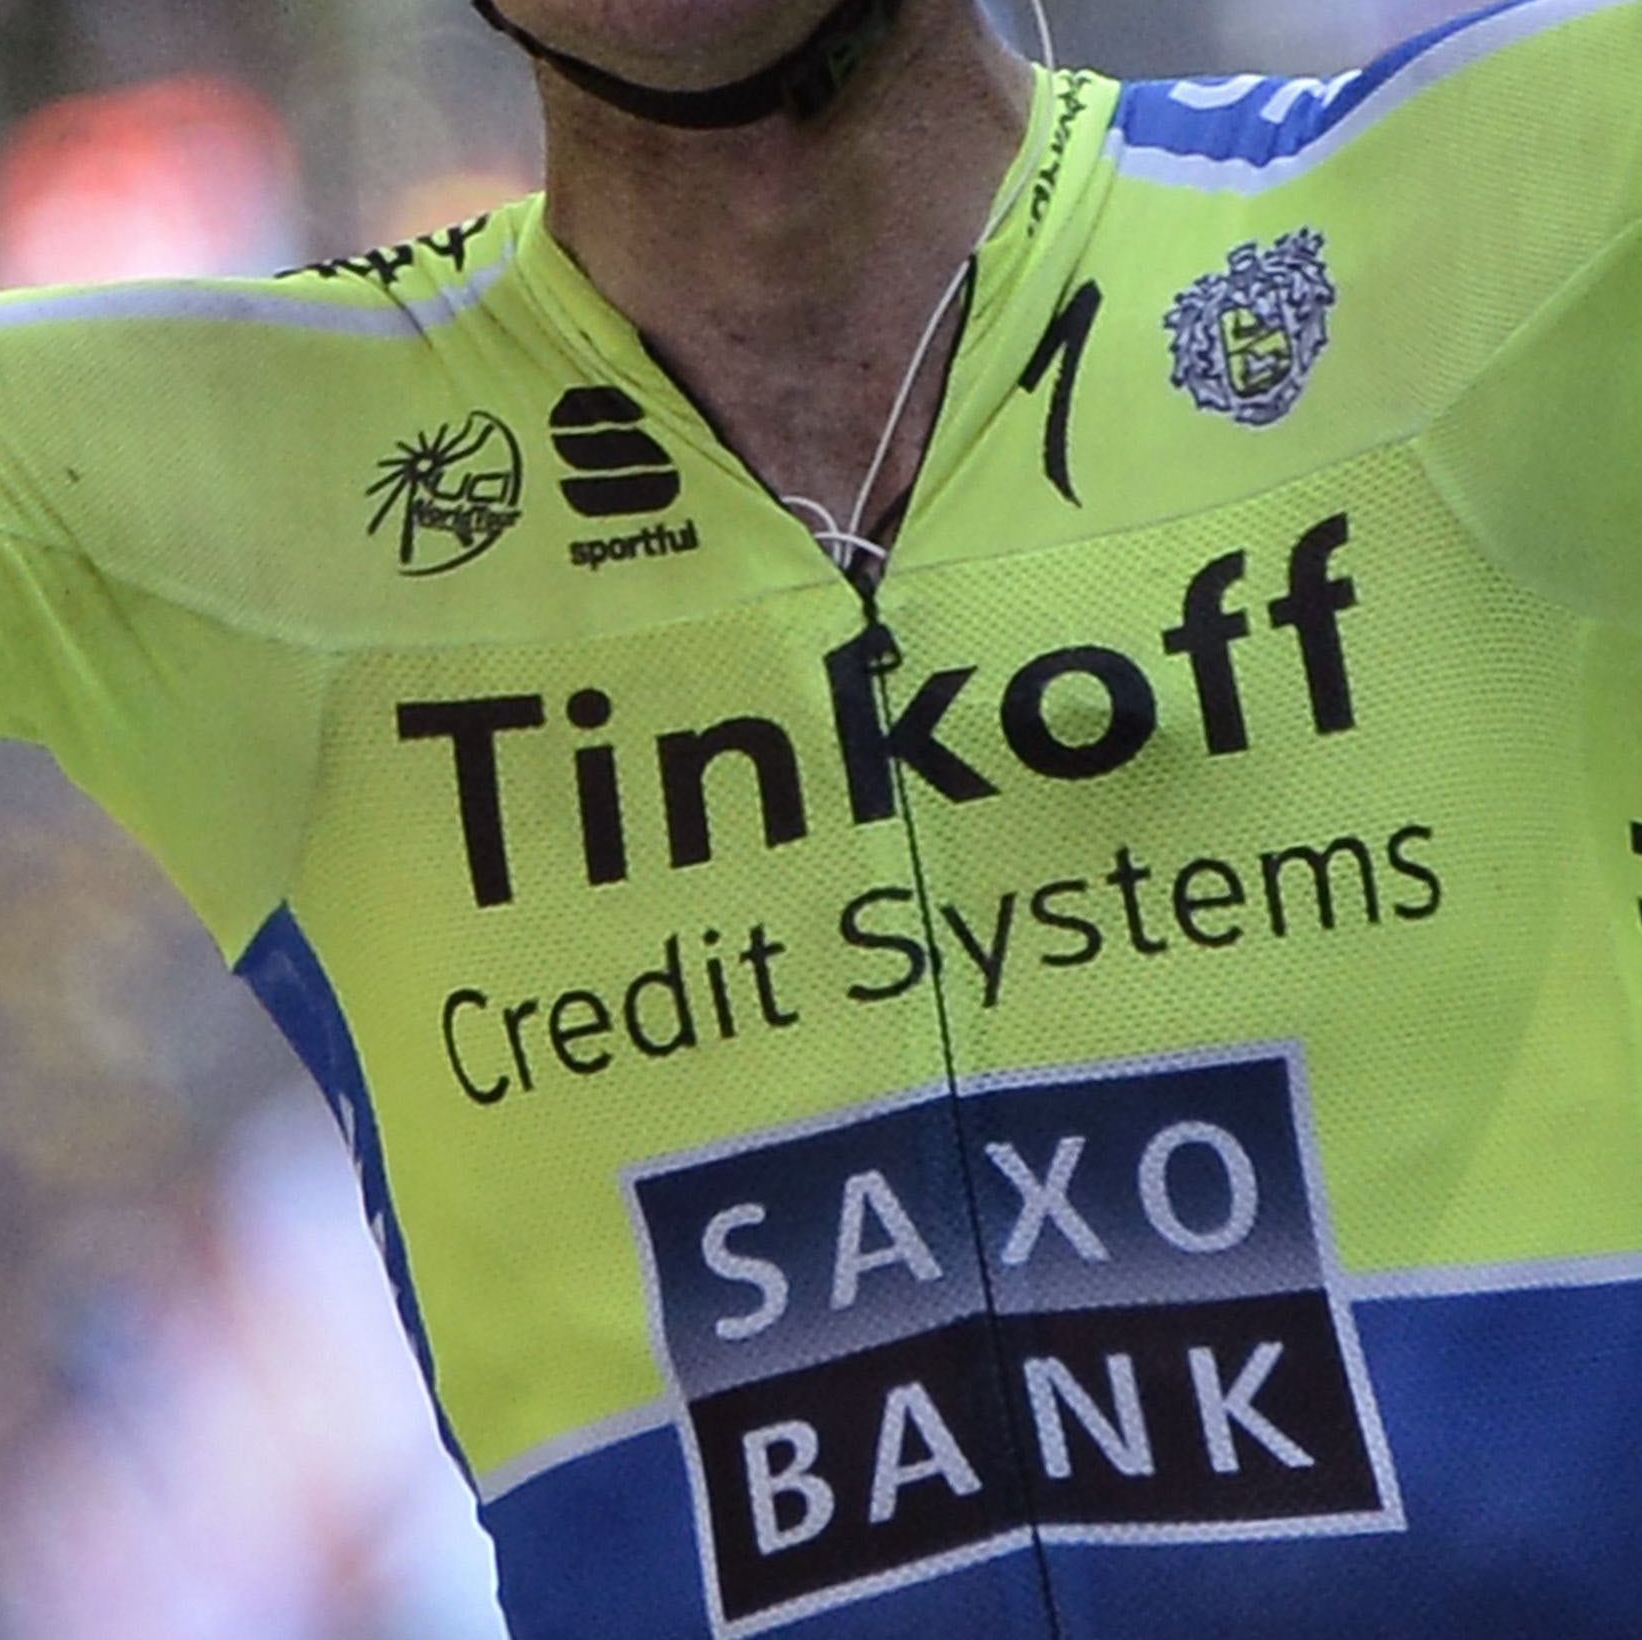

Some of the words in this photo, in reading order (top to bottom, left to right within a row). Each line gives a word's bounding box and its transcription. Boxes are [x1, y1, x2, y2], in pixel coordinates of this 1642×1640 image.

[569, 519, 699, 571] sportful
[396, 513, 1355, 908] Tinkoff
[442, 923, 799, 1107] Credit
[839, 824, 1442, 1008] Systems
[701, 1121, 1259, 1342] SAXO
[742, 1341, 1316, 1556] BANK
